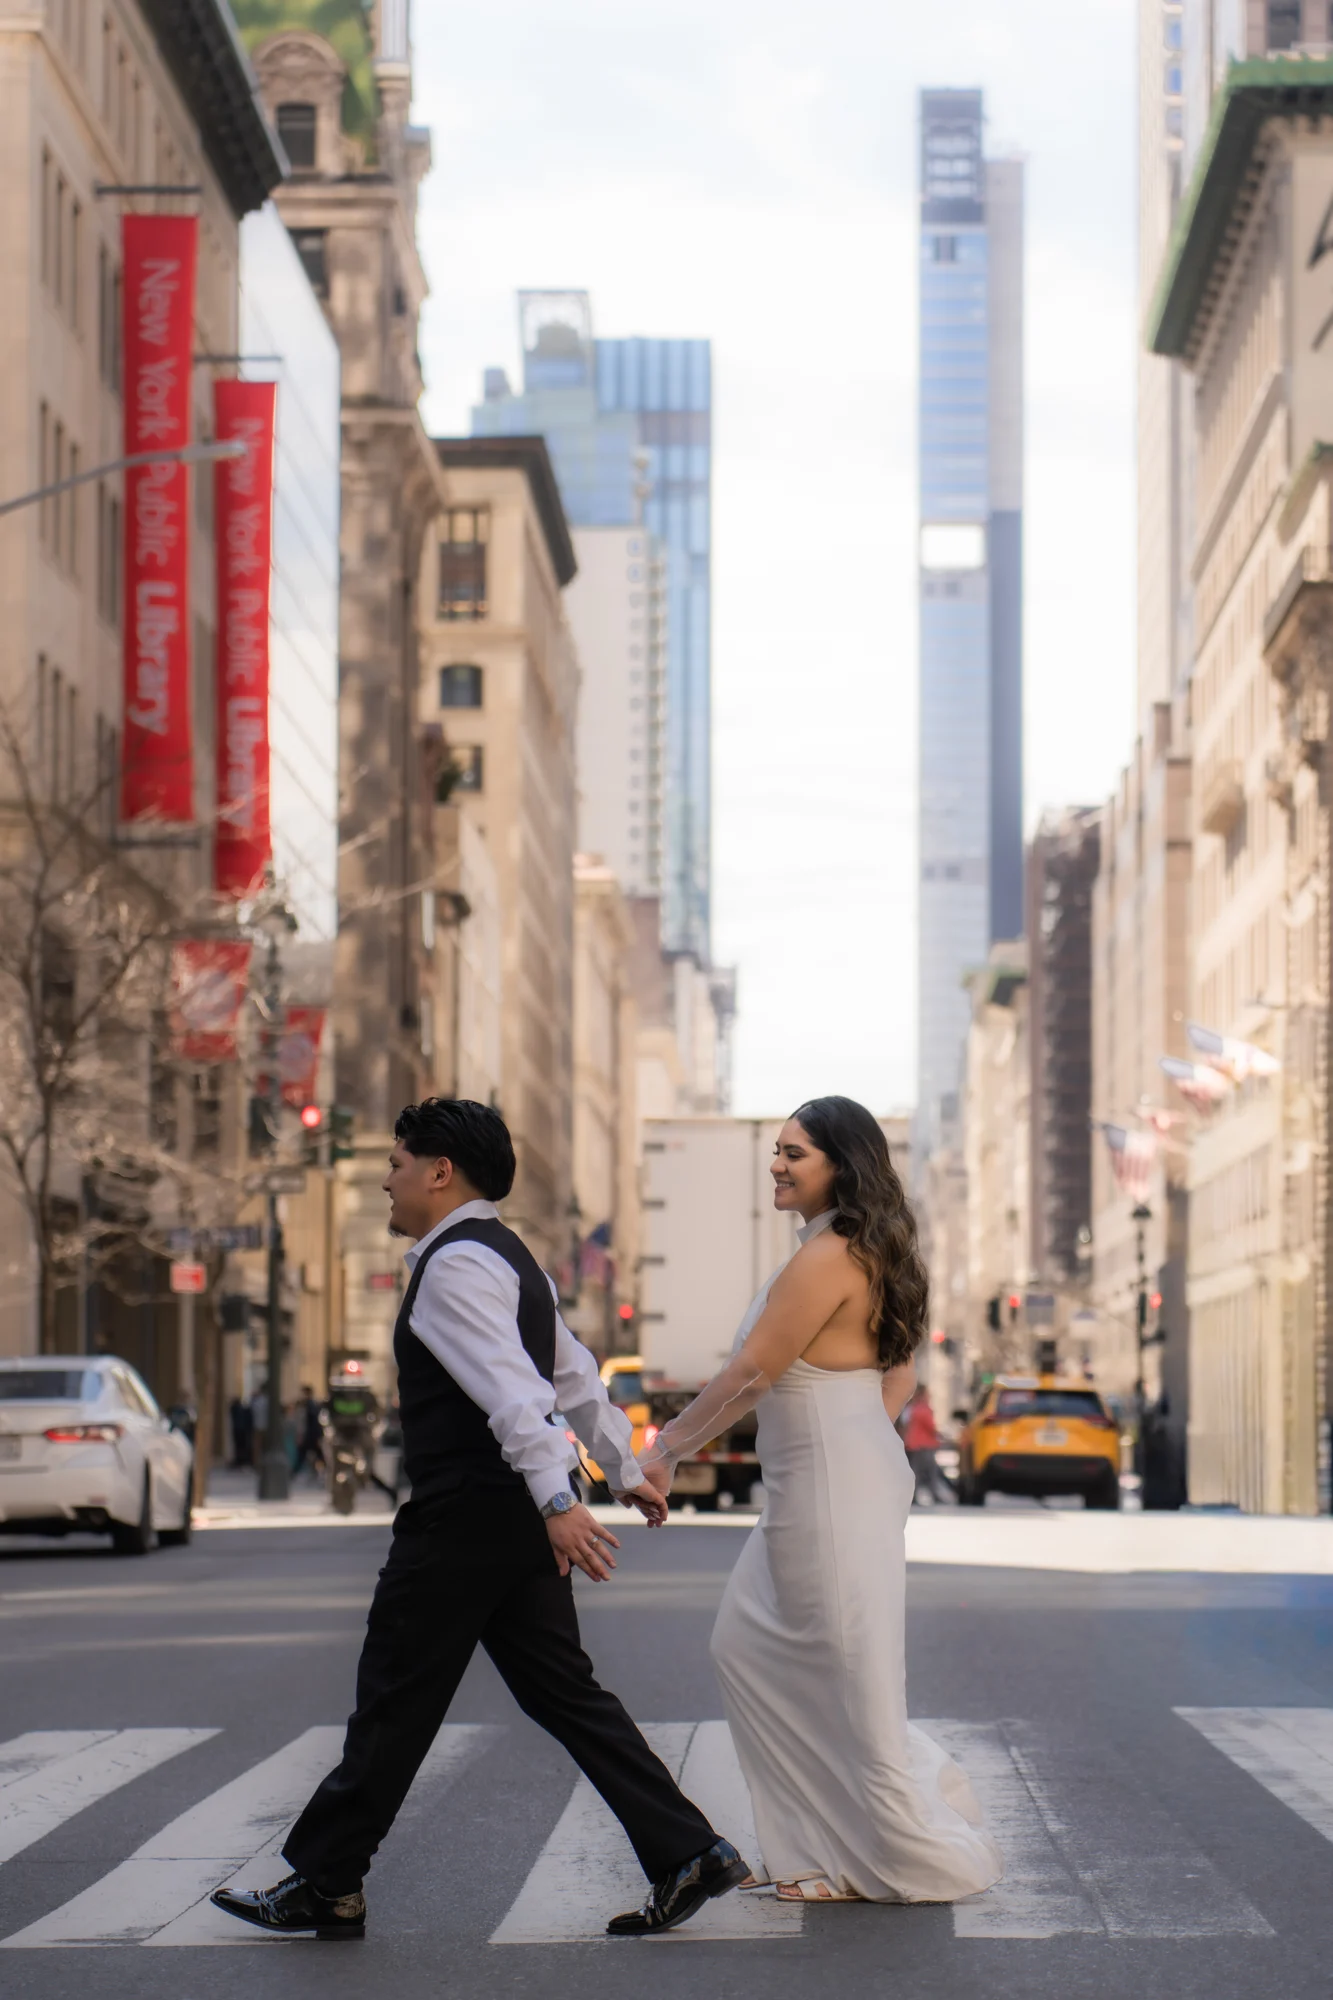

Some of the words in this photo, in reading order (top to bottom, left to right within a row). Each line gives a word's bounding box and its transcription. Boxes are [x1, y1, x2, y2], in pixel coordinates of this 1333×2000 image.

[139, 258, 181, 346] New
[136, 356, 179, 441] York
[135, 458, 179, 567] Public
[227, 503, 264, 578] York
[128, 580, 179, 736] Library
[227, 587, 265, 687] Public
